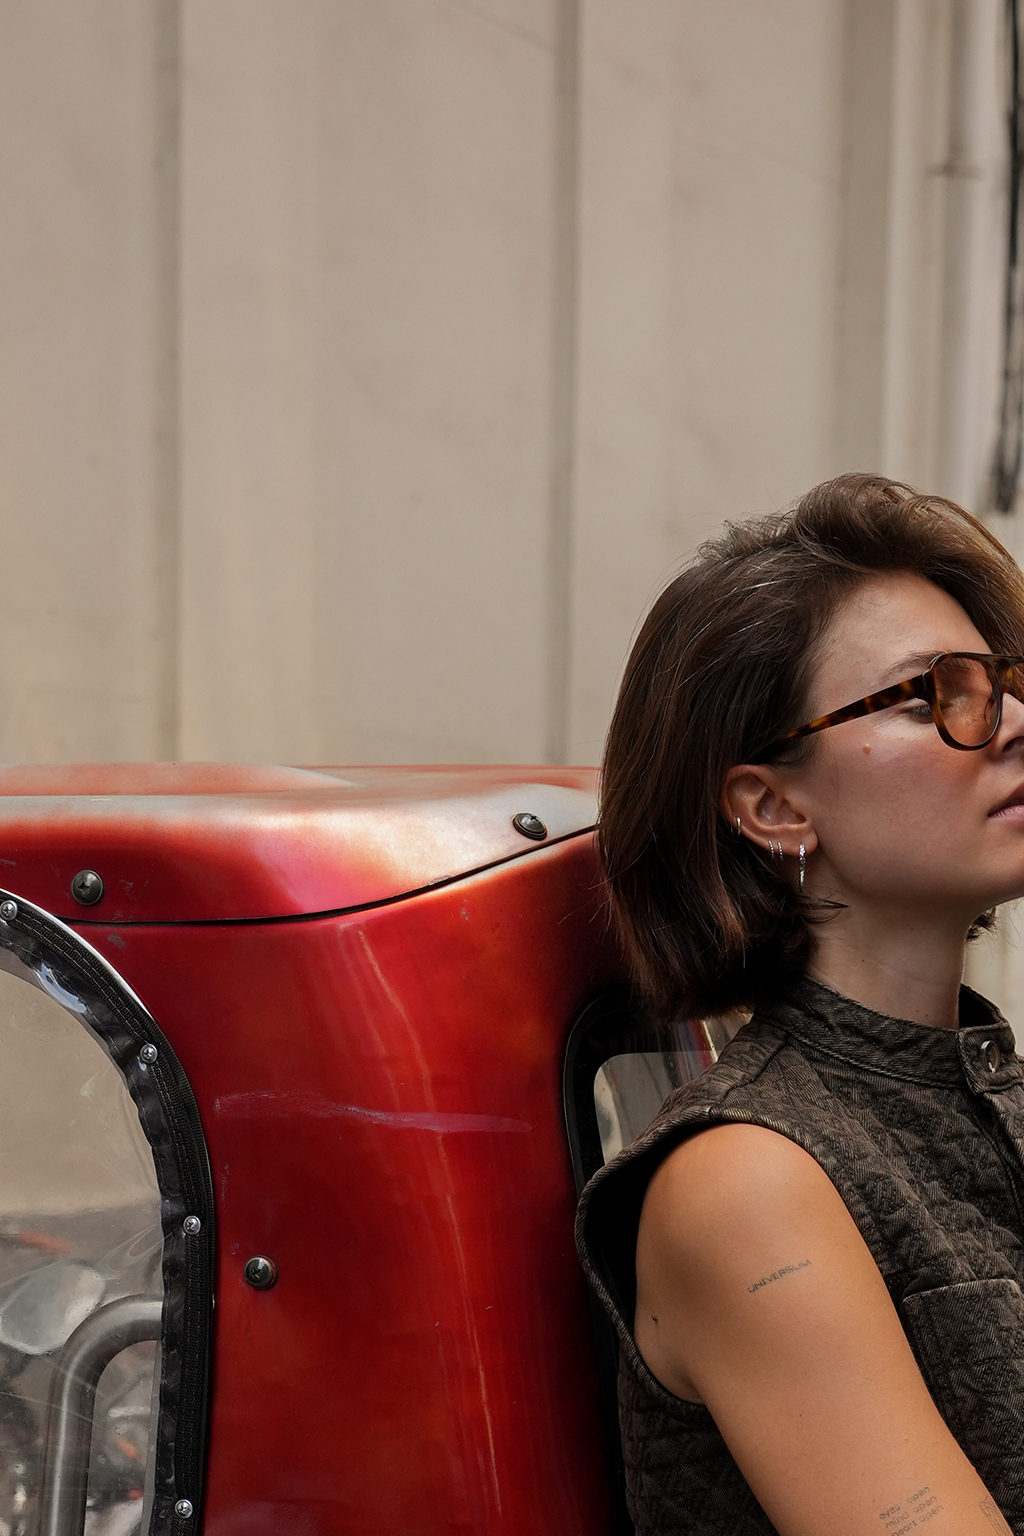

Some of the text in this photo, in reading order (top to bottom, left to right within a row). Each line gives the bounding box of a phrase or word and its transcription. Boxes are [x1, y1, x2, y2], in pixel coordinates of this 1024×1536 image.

[746, 1259, 812, 1294] UNIVERSUM
[879, 1486, 931, 1520] eyes open
[885, 1496, 938, 1530] mind open
[918, 1505, 944, 1523] open
